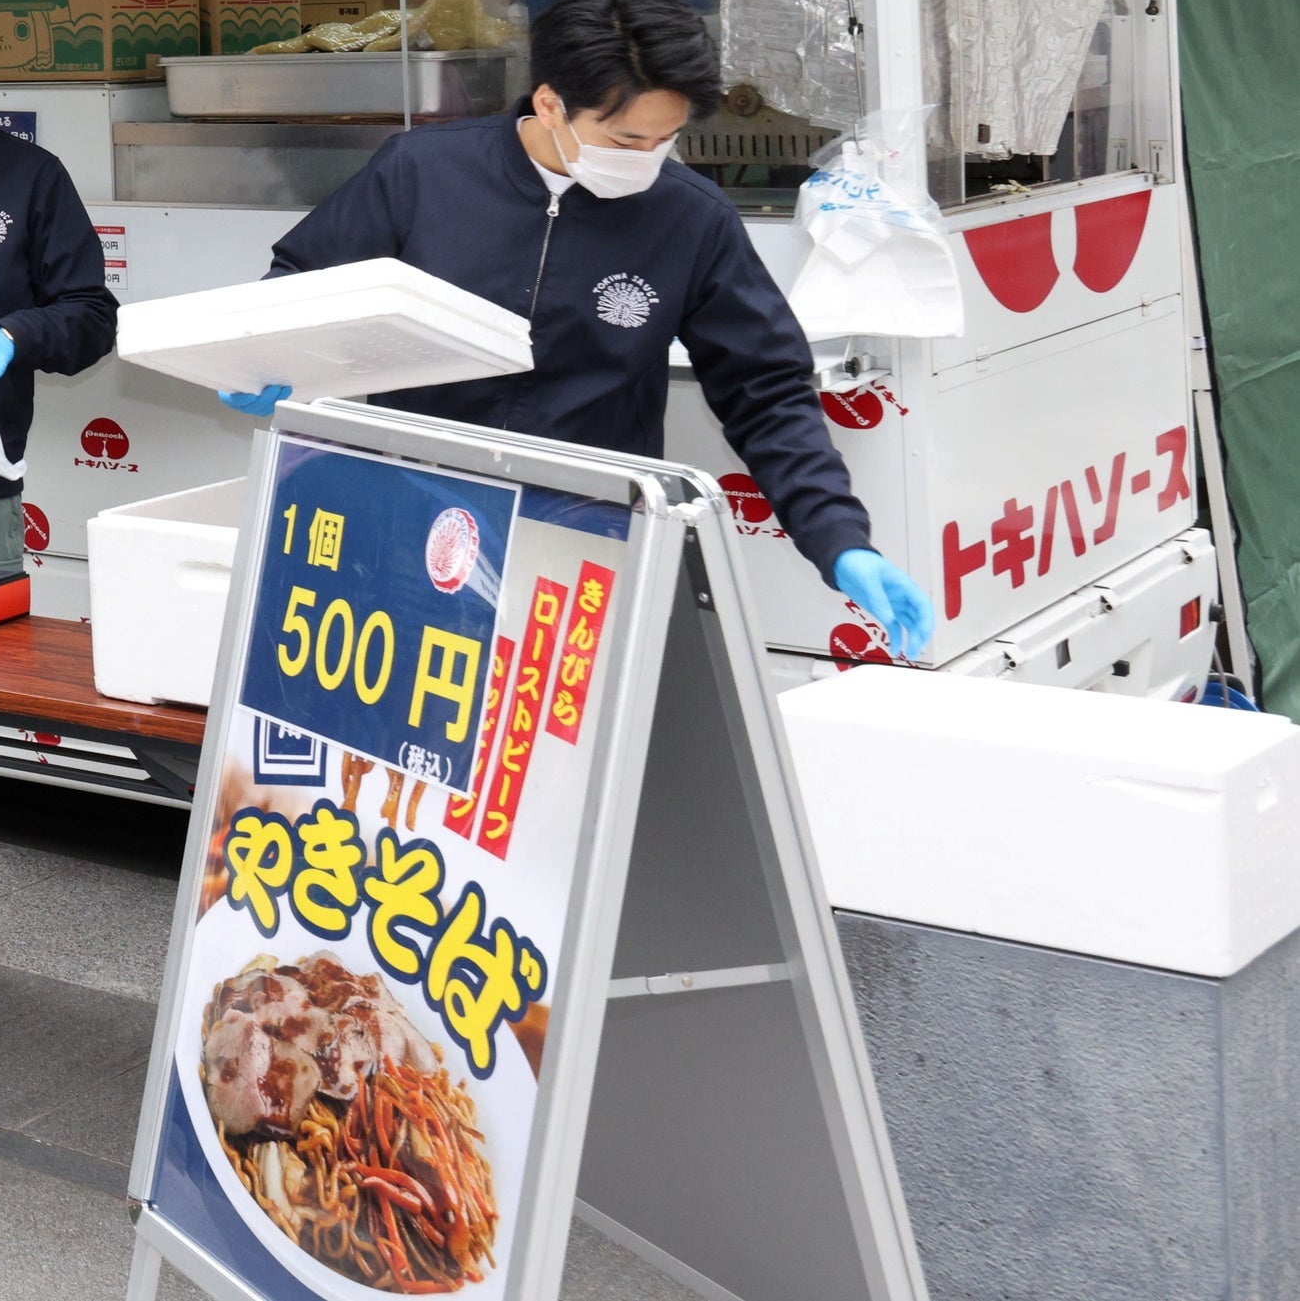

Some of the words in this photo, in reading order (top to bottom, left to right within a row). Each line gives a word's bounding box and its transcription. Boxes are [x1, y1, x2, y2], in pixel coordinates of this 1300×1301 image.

[592, 272, 627, 295] TOKIWA
[631, 274, 660, 305] SAUCE
[943, 425, 1190, 621] トキハソース
[551, 578, 605, 727] きんぴら
[225, 802, 545, 1076] やきそば
